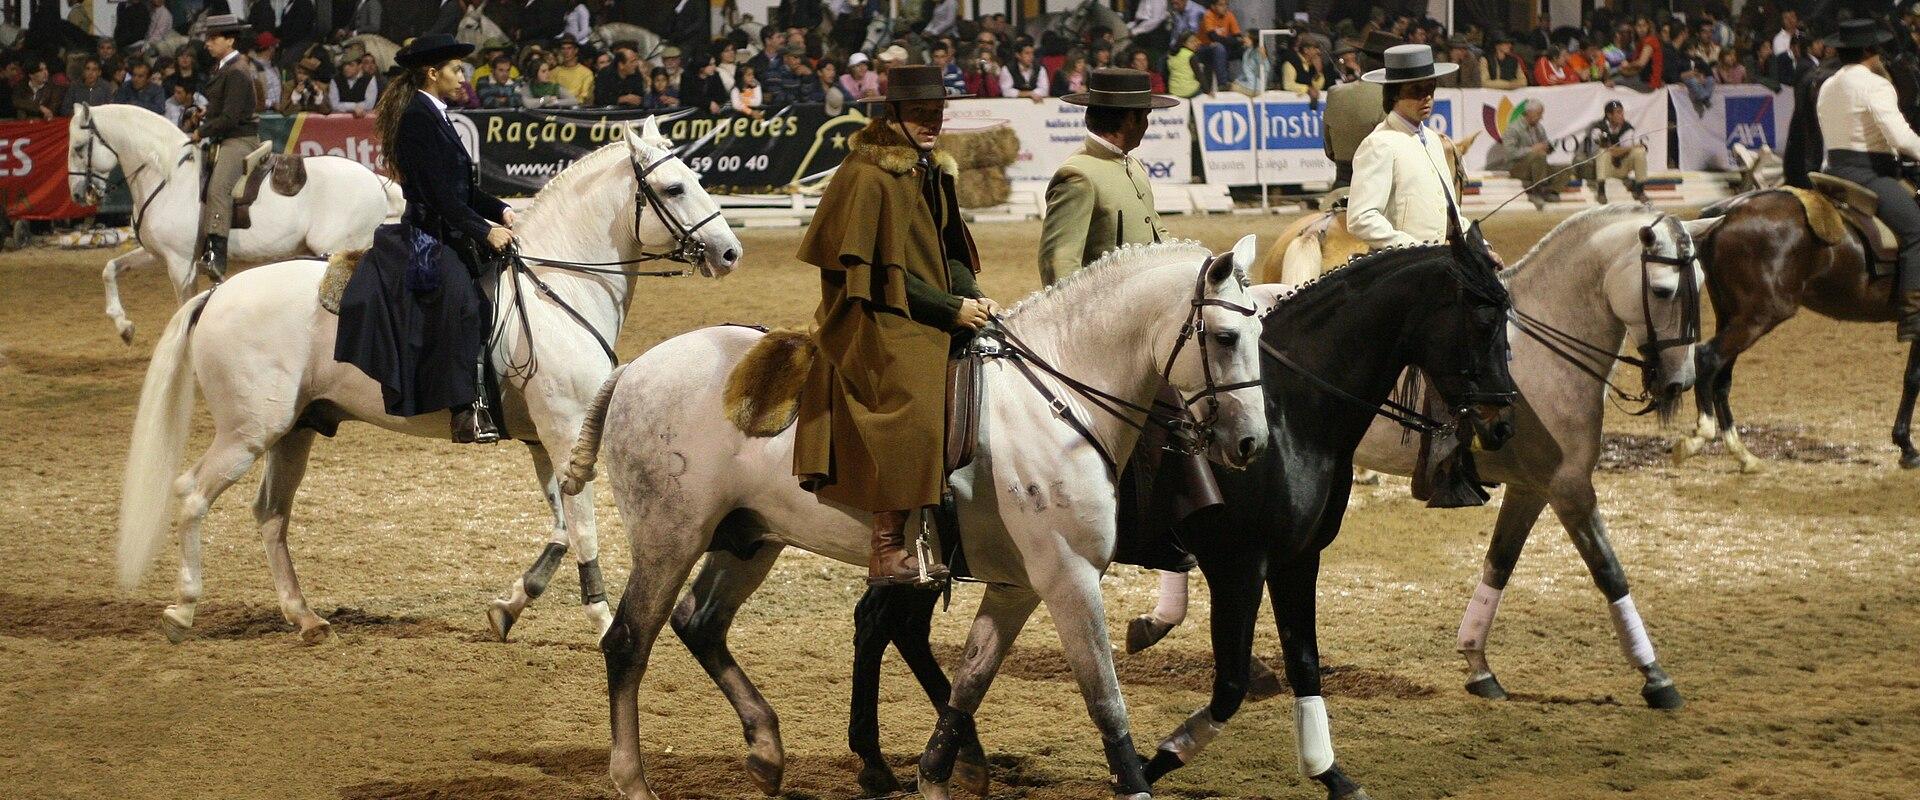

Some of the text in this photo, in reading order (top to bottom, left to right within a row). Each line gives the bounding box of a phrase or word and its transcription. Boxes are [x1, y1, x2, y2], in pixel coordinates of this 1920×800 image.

[486, 115, 577, 150] Ração
[656, 114, 798, 145] ampeões
[1264, 110, 1324, 138] insti
[1727, 123, 1768, 147] AXA
[717, 155, 741, 172] 00
[745, 154, 769, 171] 40
